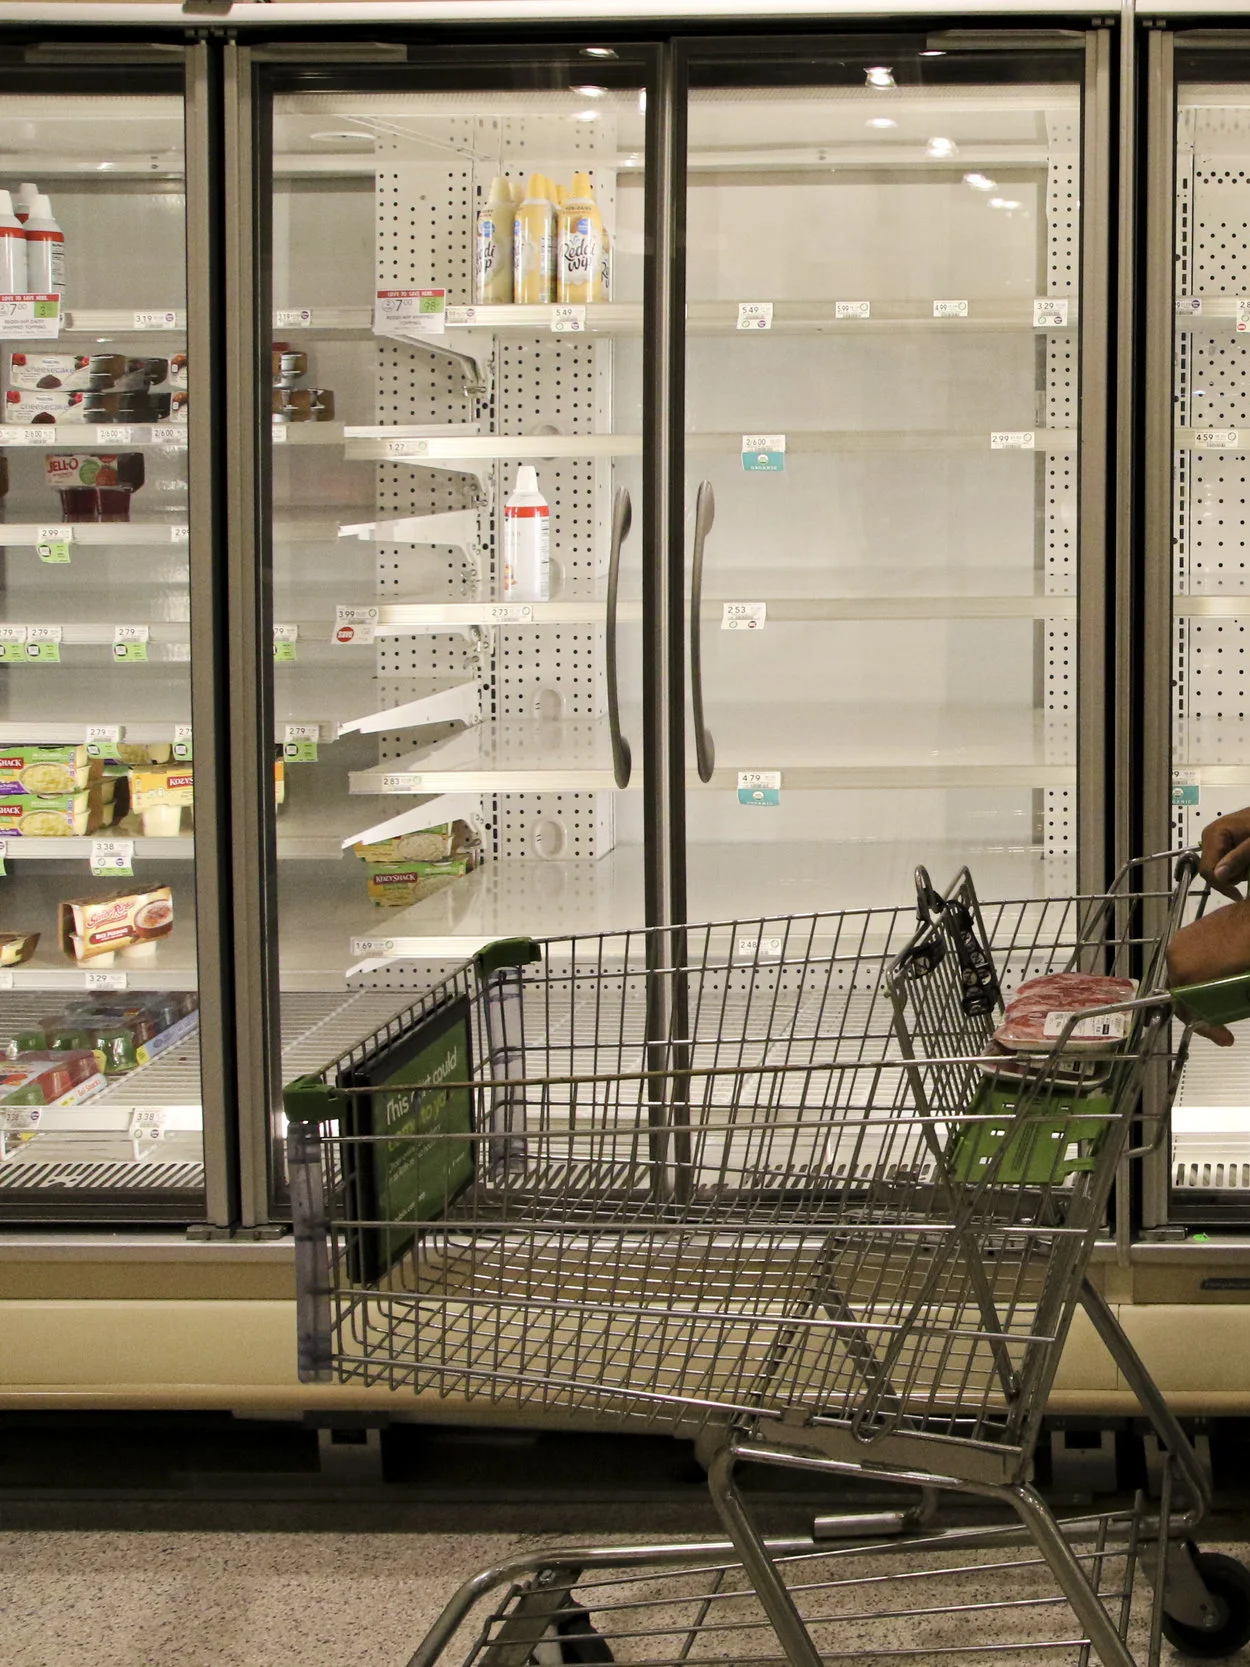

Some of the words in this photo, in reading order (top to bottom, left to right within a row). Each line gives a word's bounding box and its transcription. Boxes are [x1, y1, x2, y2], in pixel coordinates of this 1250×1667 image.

[26, 366, 75, 374] cheesecake
[20, 403, 70, 411] cheesecake
[47, 457, 79, 473] JELL-O
[386, 1093, 410, 1126] This
[432, 1045, 457, 1085] could
